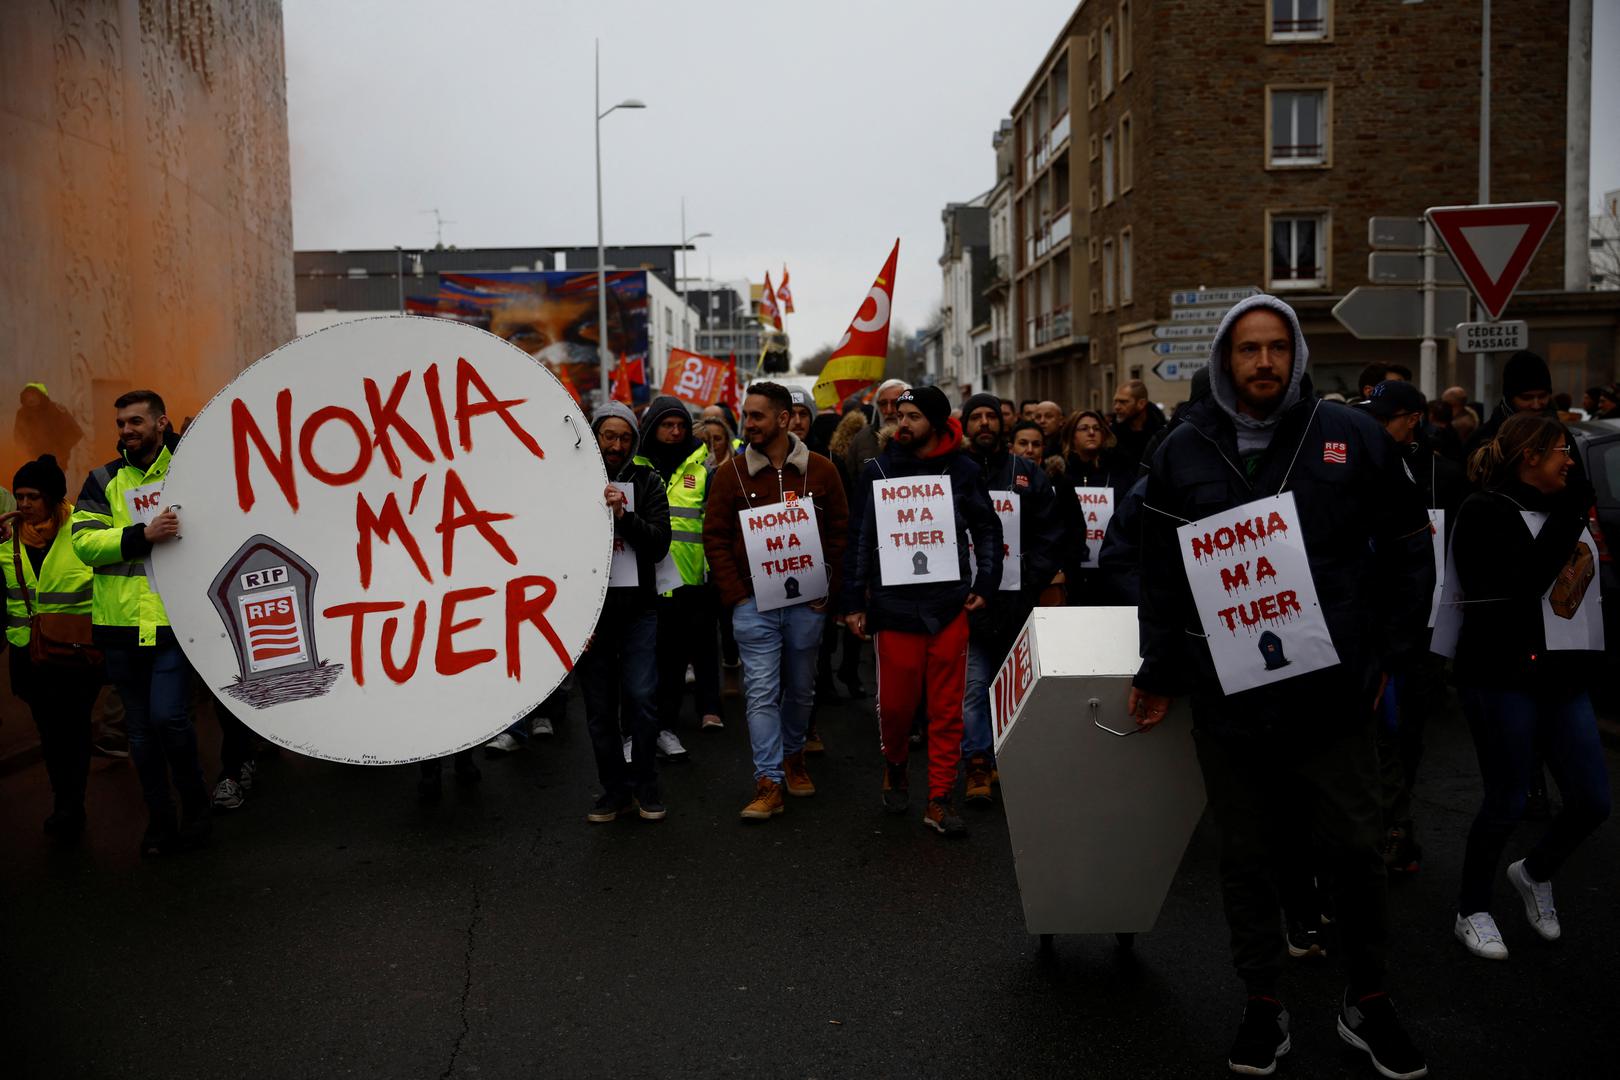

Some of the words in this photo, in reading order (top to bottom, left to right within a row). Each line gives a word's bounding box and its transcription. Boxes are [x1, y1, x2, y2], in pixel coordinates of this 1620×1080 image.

[1467, 326, 1504, 337] CÉDEZ
[1505, 326, 1519, 336] LE
[1467, 337, 1519, 349] PASSAGE
[231, 357, 544, 513] NOKIA
[1325, 442, 1345, 450] RFS
[882, 482, 945, 501] NOKIA
[748, 508, 809, 531] NOKIA
[897, 507, 933, 523] M'A
[356, 469, 519, 590] M'A
[890, 530, 945, 547] TUER
[1191, 511, 1288, 560] NOKIA
[766, 533, 801, 552] M'A
[762, 554, 814, 576] TUER
[1220, 556, 1277, 594] M'A
[245, 568, 284, 588] RIP
[248, 599, 290, 620] RFS
[1218, 589, 1302, 632] TUER
[323, 575, 574, 687] TUER
[1018, 630, 1032, 691] RFS
